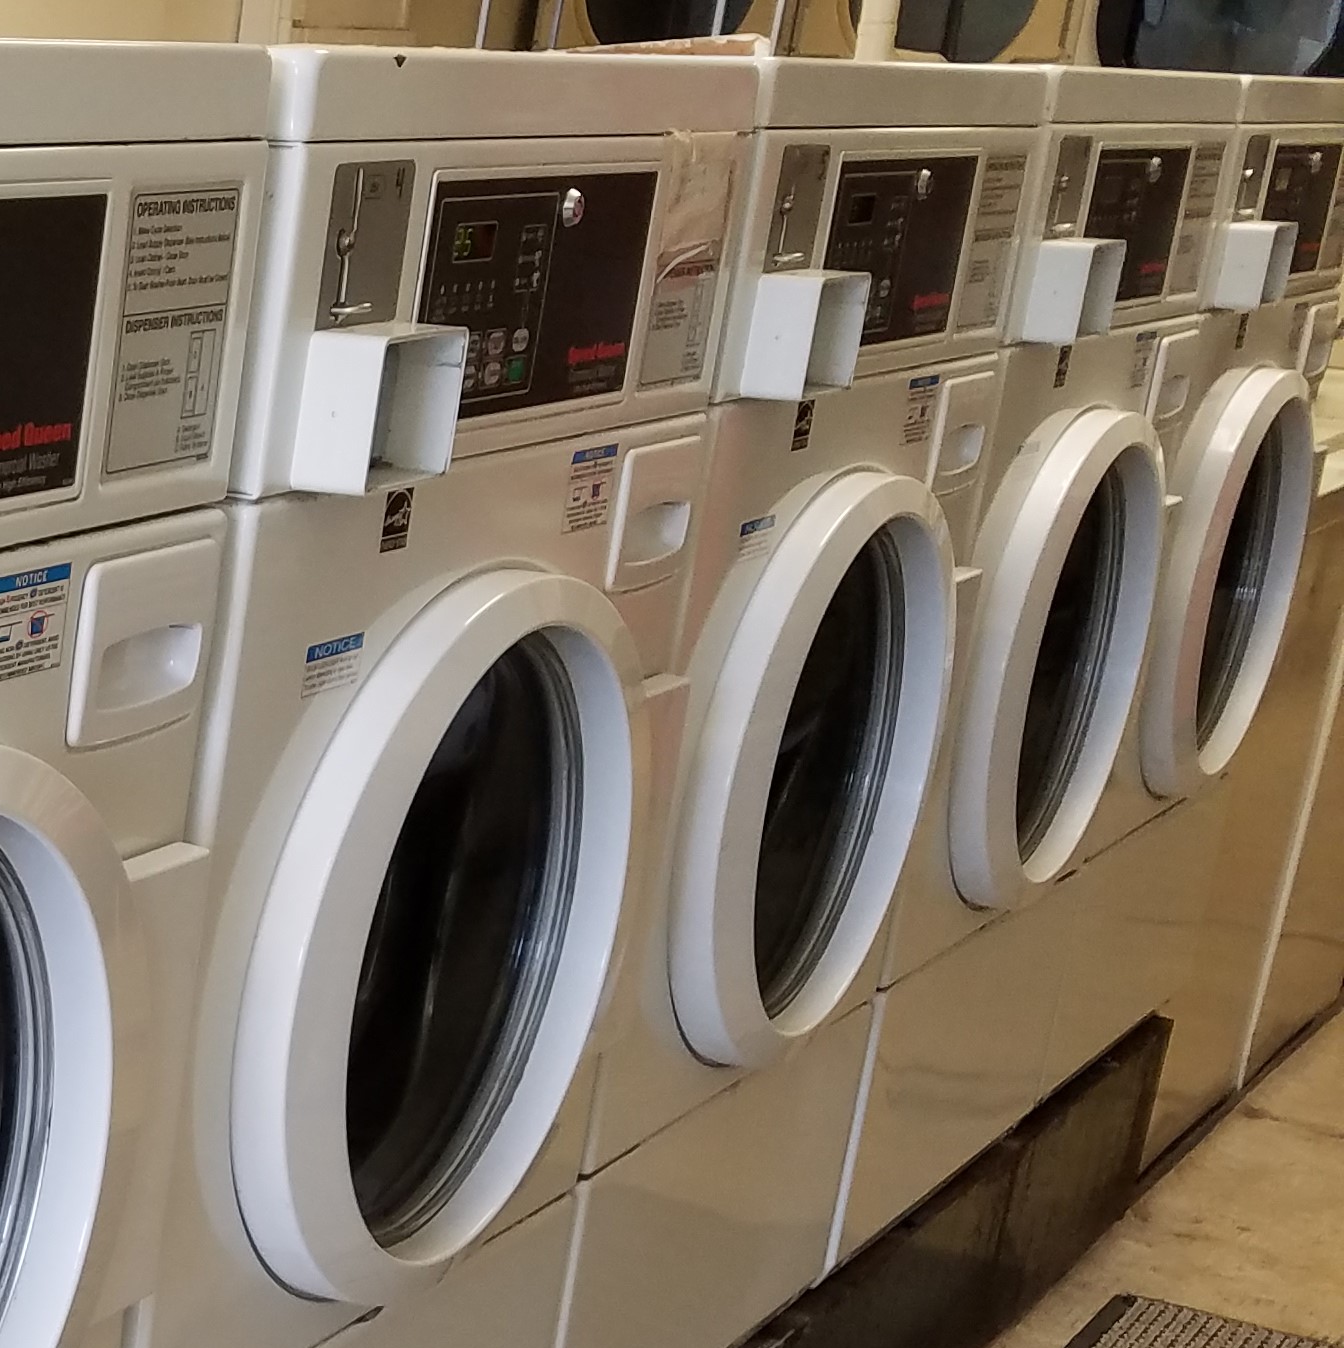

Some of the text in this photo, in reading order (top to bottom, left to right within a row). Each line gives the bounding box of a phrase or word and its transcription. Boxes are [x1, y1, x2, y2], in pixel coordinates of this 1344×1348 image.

[137, 196, 235, 217] OPERATING INSTRUCTIONS
[16, 571, 48, 586] NOTICE
[315, 637, 356, 659] NOTICE
